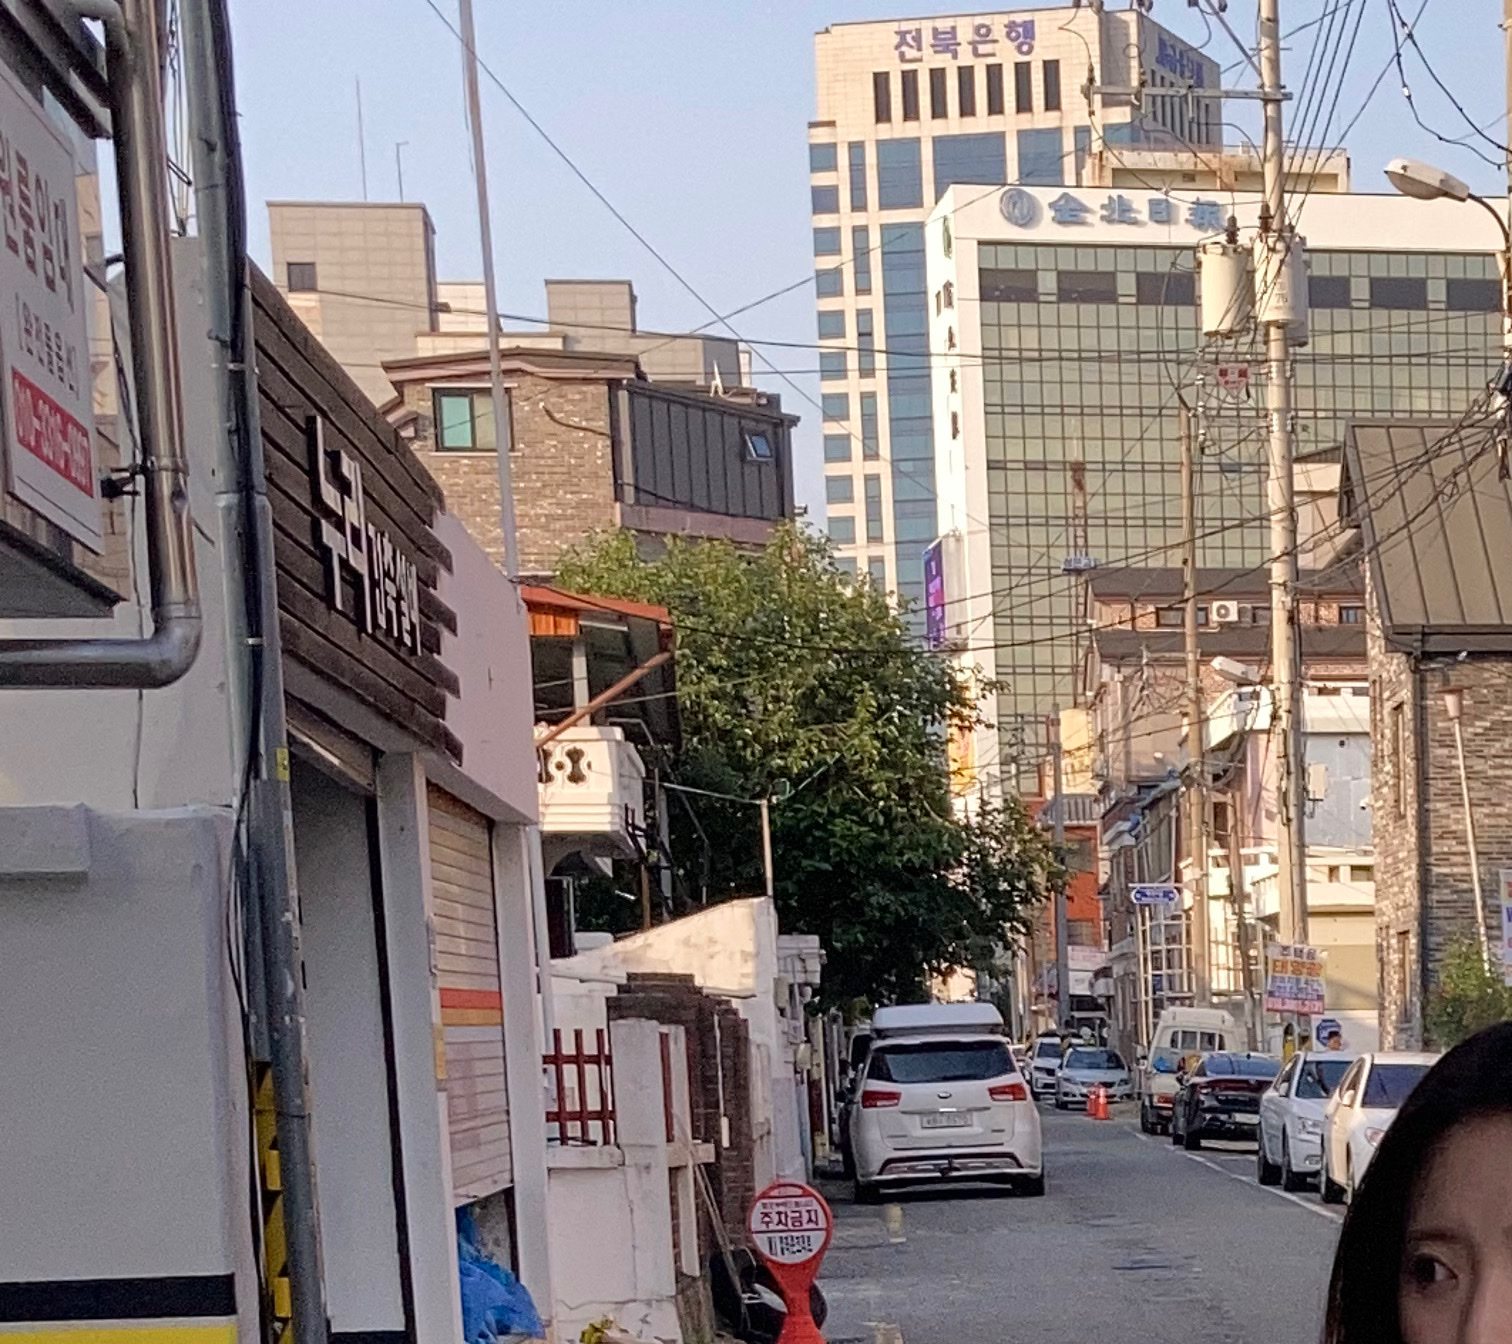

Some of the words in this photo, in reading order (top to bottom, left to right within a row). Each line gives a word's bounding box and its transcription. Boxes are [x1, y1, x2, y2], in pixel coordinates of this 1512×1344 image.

[894, 19, 1036, 63] 전북은행
[315, 415, 373, 634] 누리
[759, 1209, 819, 1228] 주차금지
